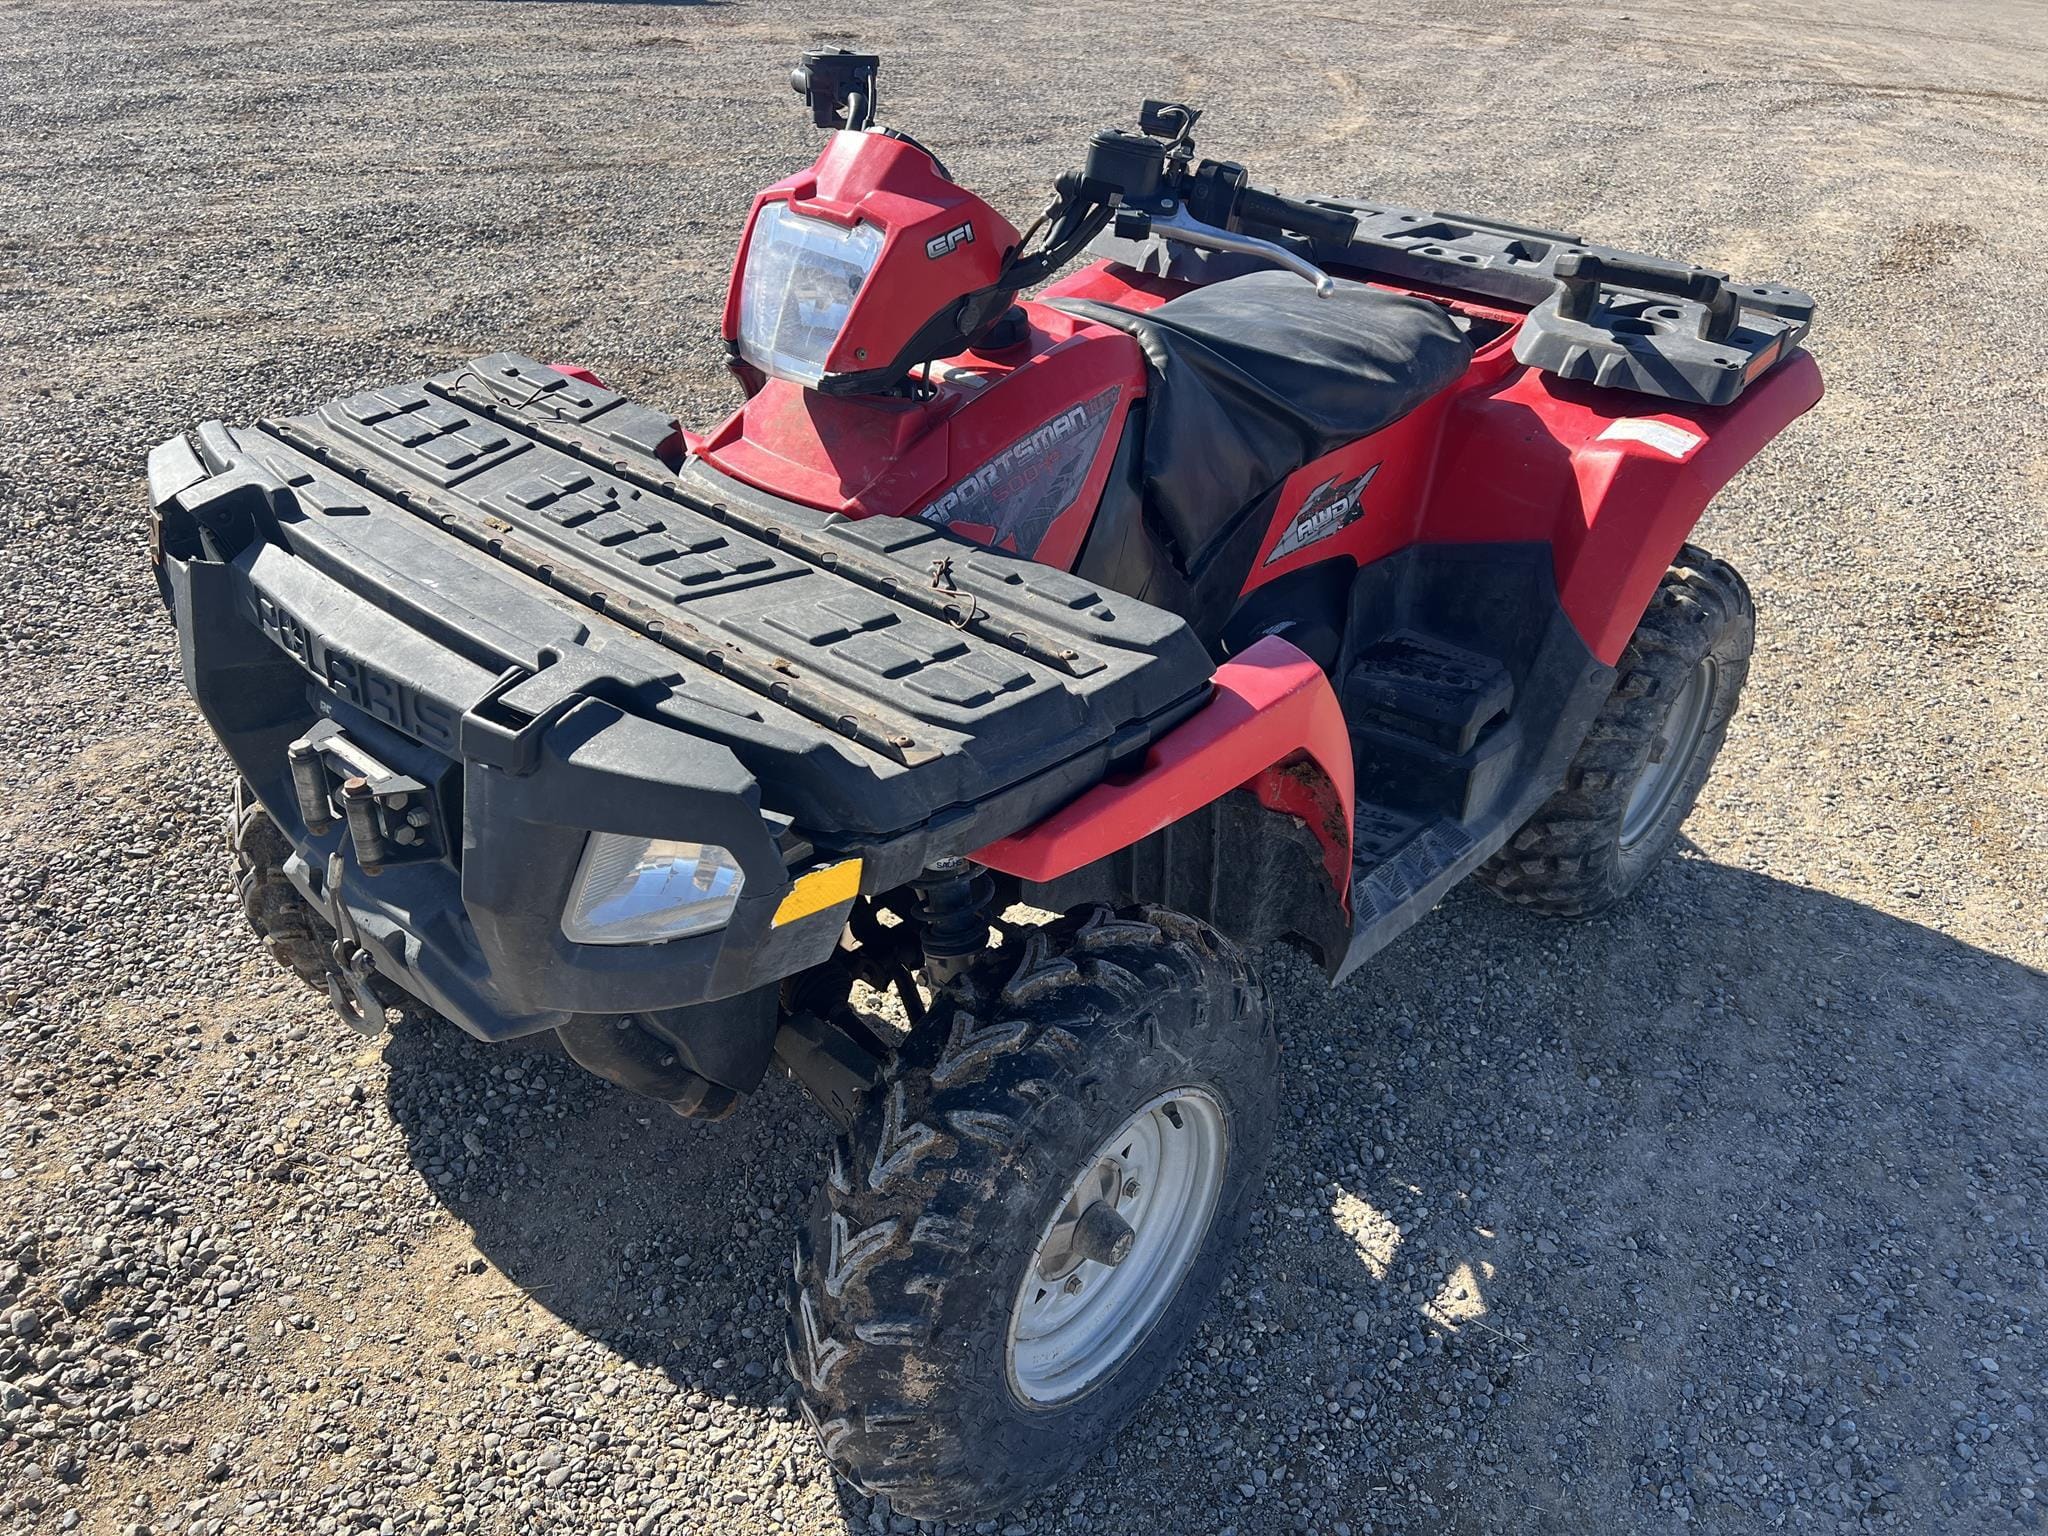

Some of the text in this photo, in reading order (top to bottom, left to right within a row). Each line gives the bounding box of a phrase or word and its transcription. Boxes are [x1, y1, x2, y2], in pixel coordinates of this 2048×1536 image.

[926, 222, 974, 258] EFI
[1297, 497, 1350, 541] AWD
[251, 584, 454, 745] POLARIS
